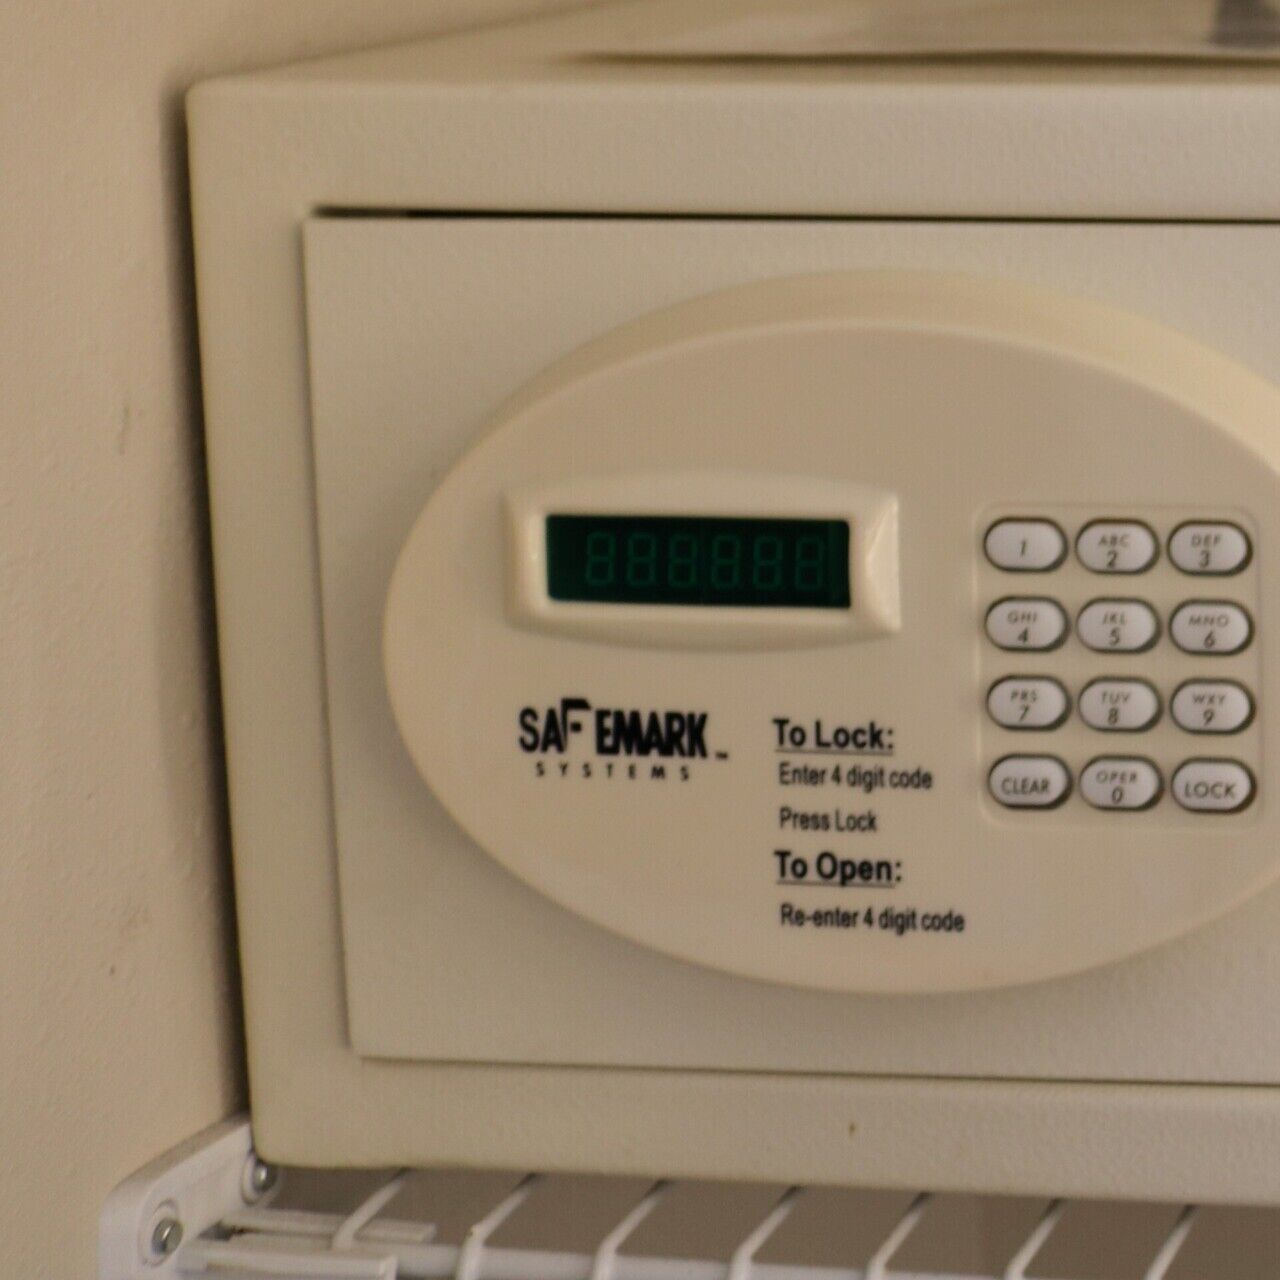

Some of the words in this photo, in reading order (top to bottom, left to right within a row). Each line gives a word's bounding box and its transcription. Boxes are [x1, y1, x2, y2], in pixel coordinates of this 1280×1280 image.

[1098, 534, 1131, 548] ABC
[1191, 535, 1222, 548] DEF
[1106, 550, 1118, 568] 2
[1199, 551, 1211, 568] 3
[1017, 627, 1029, 643] 4
[1108, 627, 1120, 645] 5
[1203, 630, 1216, 648] 6
[1100, 691, 1131, 704] TUV
[1018, 705, 1030, 722] 7
[1107, 707, 1120, 725] 8
[1203, 708, 1215, 726] 9
[773, 717, 807, 747] To
[814, 719, 894, 750] Lock:
[536, 761, 690, 782] SYSTEMS
[778, 762, 826, 786] Enter
[831, 765, 842, 785] 4
[846, 765, 885, 794] digit
[889, 766, 933, 790] code
[1096, 770, 1138, 784] OPER
[1001, 776, 1050, 795] CLEAR
[1184, 781, 1237, 800] LOCK
[779, 807, 830, 831] Press
[835, 809, 878, 832] Lock
[773, 850, 808, 879] To
[816, 851, 902, 887] Open:
[780, 903, 859, 928] Re-enter
[863, 908, 874, 927] 4
[878, 908, 918, 936] digit
[921, 910, 966, 932] code
